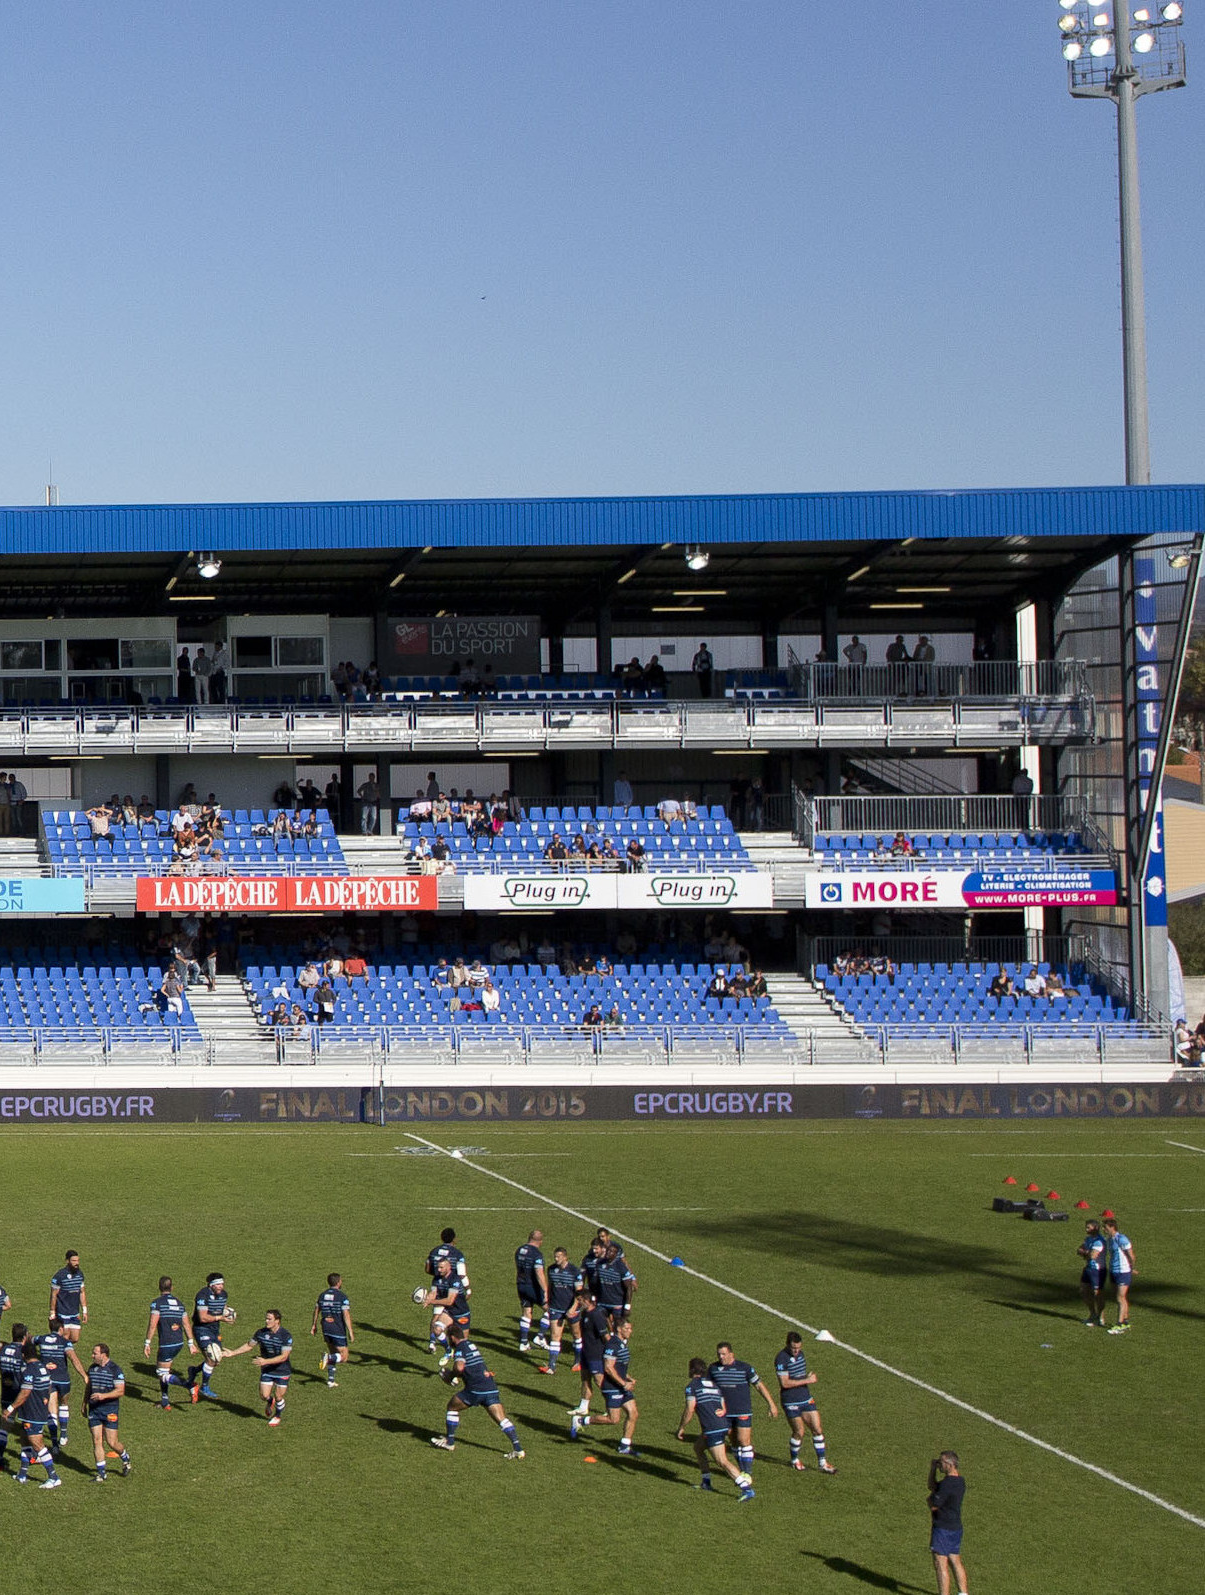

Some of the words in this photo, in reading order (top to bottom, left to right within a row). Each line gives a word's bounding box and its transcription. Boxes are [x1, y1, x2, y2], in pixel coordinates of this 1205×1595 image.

[431, 622, 454, 638] LA
[456, 621, 528, 638] PASSION
[431, 638, 455, 655] DU
[459, 638, 516, 655] SPORT
[155, 881, 182, 906] LA
[183, 877, 278, 906] DÉPÊCHE
[295, 881, 323, 906] LA
[324, 877, 420, 906] DÉPÊCHE
[513, 883, 556, 901] Plug
[562, 878, 579, 897] in
[659, 882, 703, 901] Plug
[710, 877, 727, 896] in
[852, 875, 938, 902] MORÉ
[980, 882, 1015, 890] LITERIE
[0, 1095, 155, 1118] EPCRUGBY.FR
[259, 1092, 354, 1118] FINAL
[366, 1091, 509, 1117] LONDON
[520, 1090, 586, 1117] 2015
[633, 1092, 794, 1114] EPCRUGBY.FR
[900, 1087, 1000, 1115] FINAL
[1011, 1086, 1160, 1114] LONDON
